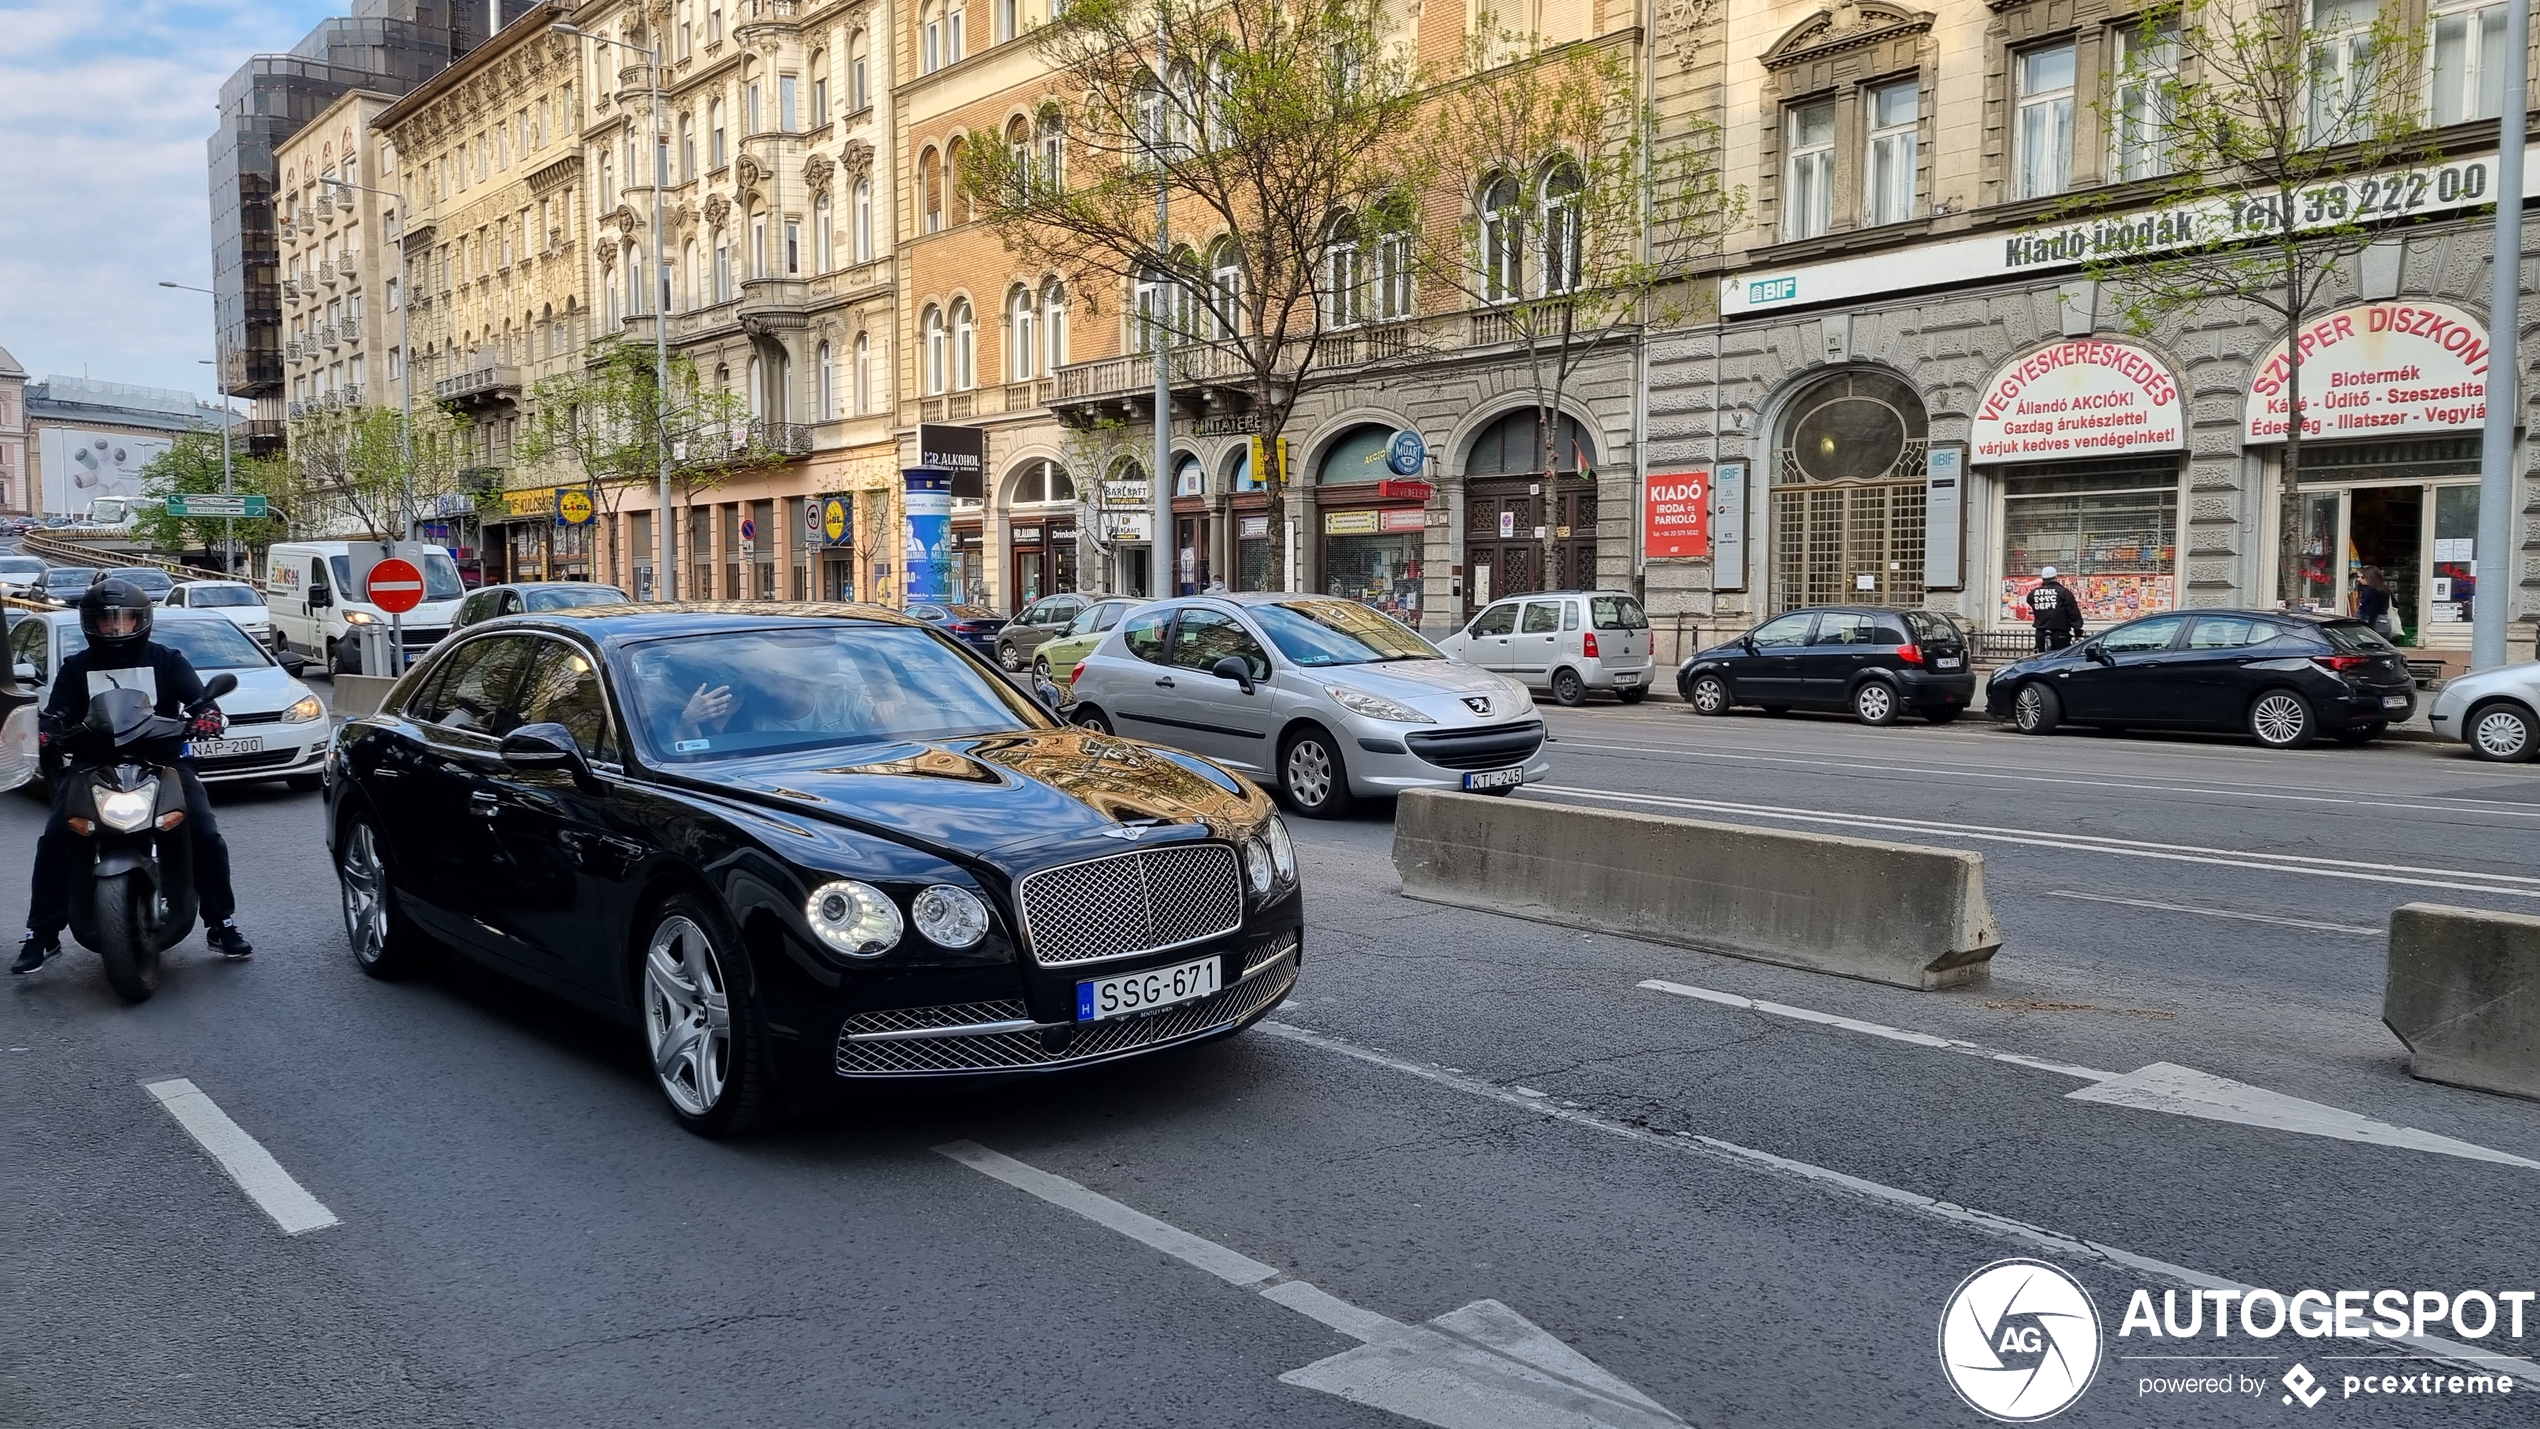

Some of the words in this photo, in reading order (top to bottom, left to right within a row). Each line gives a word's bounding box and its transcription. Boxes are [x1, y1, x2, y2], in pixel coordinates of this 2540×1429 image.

[2006, 228, 2086, 267] Kiadó
[2095, 212, 2193, 252] irodák
[2304, 186, 2348, 222] 33
[2360, 172, 2427, 213] 222
[2438, 163, 2487, 203] 00
[1763, 280, 1794, 300] BIF
[1978, 341, 2176, 422] VEGYESKERESKEDÉS
[2331, 365, 2420, 388] Biotermék
[2016, 399, 2067, 415] Állandó
[2072, 390, 2134, 411] AKCIÓK!
[2267, 396, 2308, 414] Káé
[2325, 391, 2370, 409] Üdítő
[2003, 417, 2053, 435] Gazdag
[2058, 410, 2147, 431] árukészlettel
[2251, 417, 2321, 435] Édeség
[2338, 412, 2407, 430] Illatszer
[1395, 441, 1422, 461] MUART
[1978, 438, 2018, 457] várjuk
[2022, 437, 2070, 452] kedves
[2074, 428, 2175, 449] vendégeinket!
[1938, 452, 1956, 466] BIF
[1724, 467, 1739, 480] BIF
[1650, 479, 1702, 502] KIADÓ
[1654, 511, 1697, 525] PARKOLÓ
[1656, 503, 1685, 514] IRODA
[1687, 502, 1695, 512] és
[2034, 602, 2057, 610] DEPT
[192, 739, 258, 756] NAP-200
[1473, 769, 1520, 789] KTL-245
[1082, 1003, 1090, 1014] H
[1101, 961, 1213, 1012] SSG-671
[1140, 1009, 1161, 1018] BENTLEY
